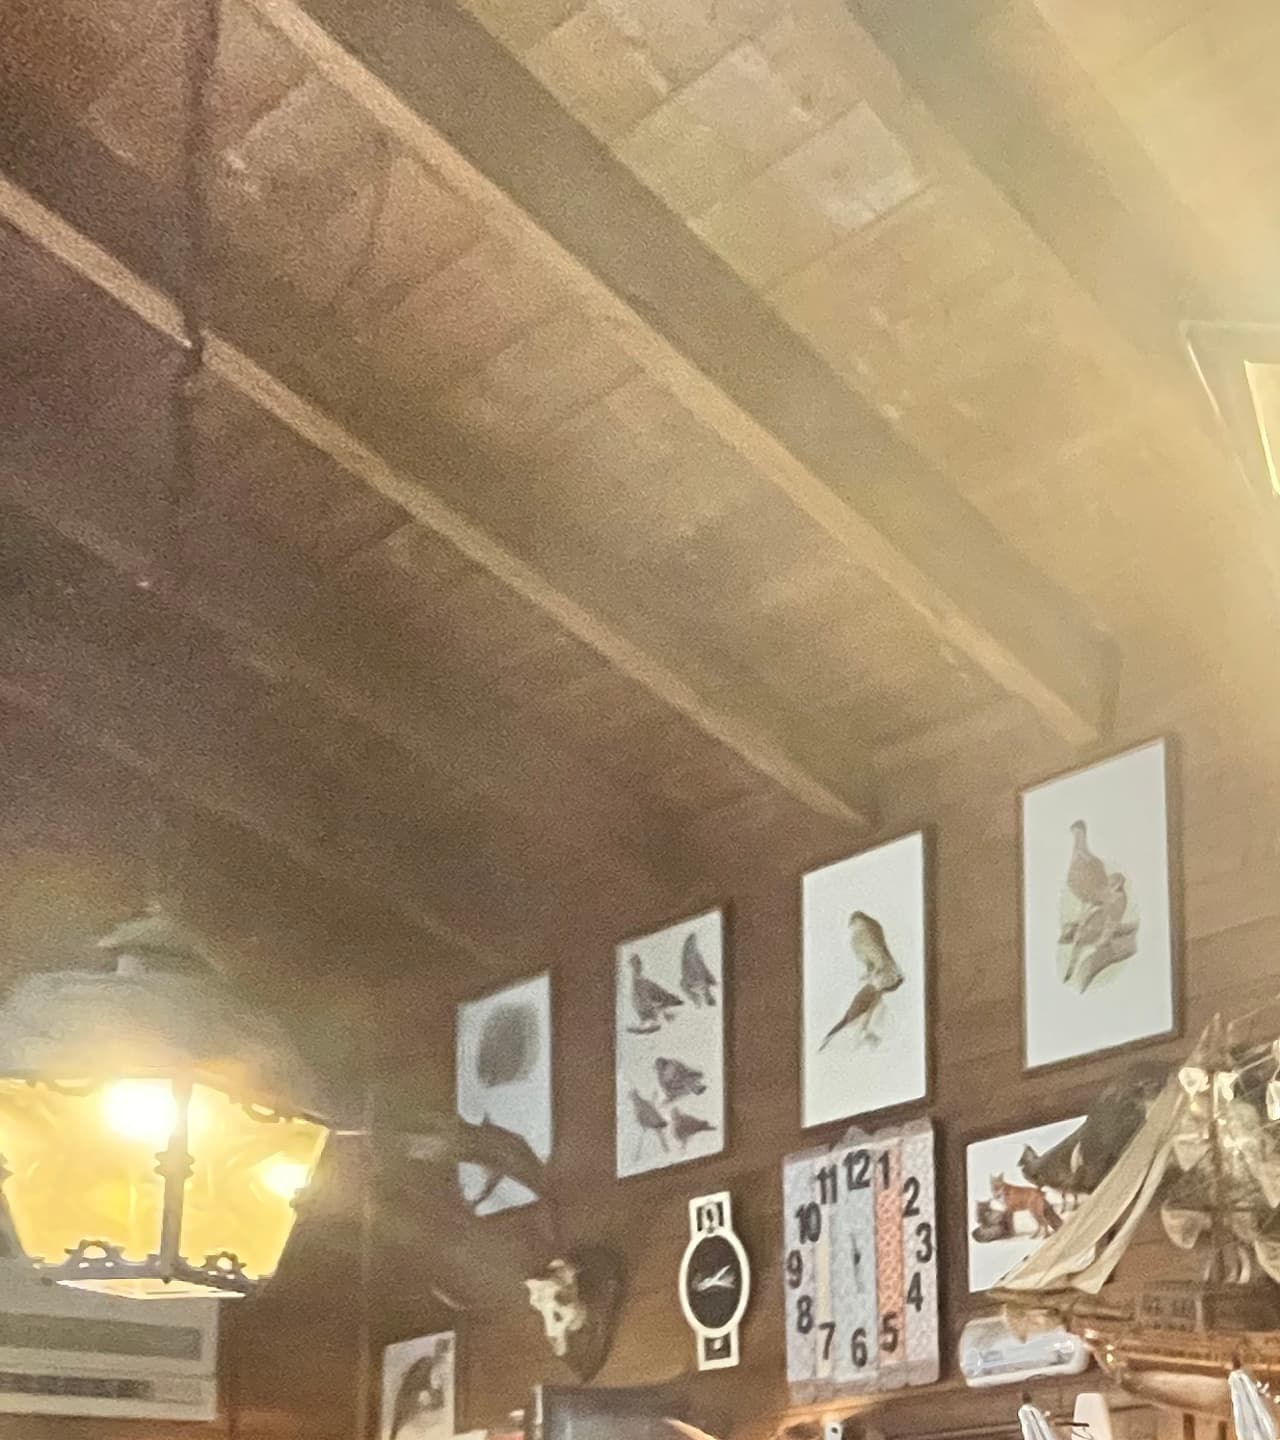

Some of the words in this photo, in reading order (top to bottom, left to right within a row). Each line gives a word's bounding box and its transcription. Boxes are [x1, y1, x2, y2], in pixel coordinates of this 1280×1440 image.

[816, 1164, 837, 1204] 11
[843, 1149, 871, 1190] 12
[878, 1150, 890, 1190] 1
[902, 1176, 920, 1217] 2
[795, 1201, 822, 1244] 10
[915, 1222, 932, 1263] 3
[786, 1250, 804, 1289] 9
[906, 1272, 923, 1312] 4
[796, 1295, 813, 1334] 8
[879, 1311, 899, 1353] 5
[817, 1321, 835, 1360] 7
[850, 1327, 868, 1367] 6
